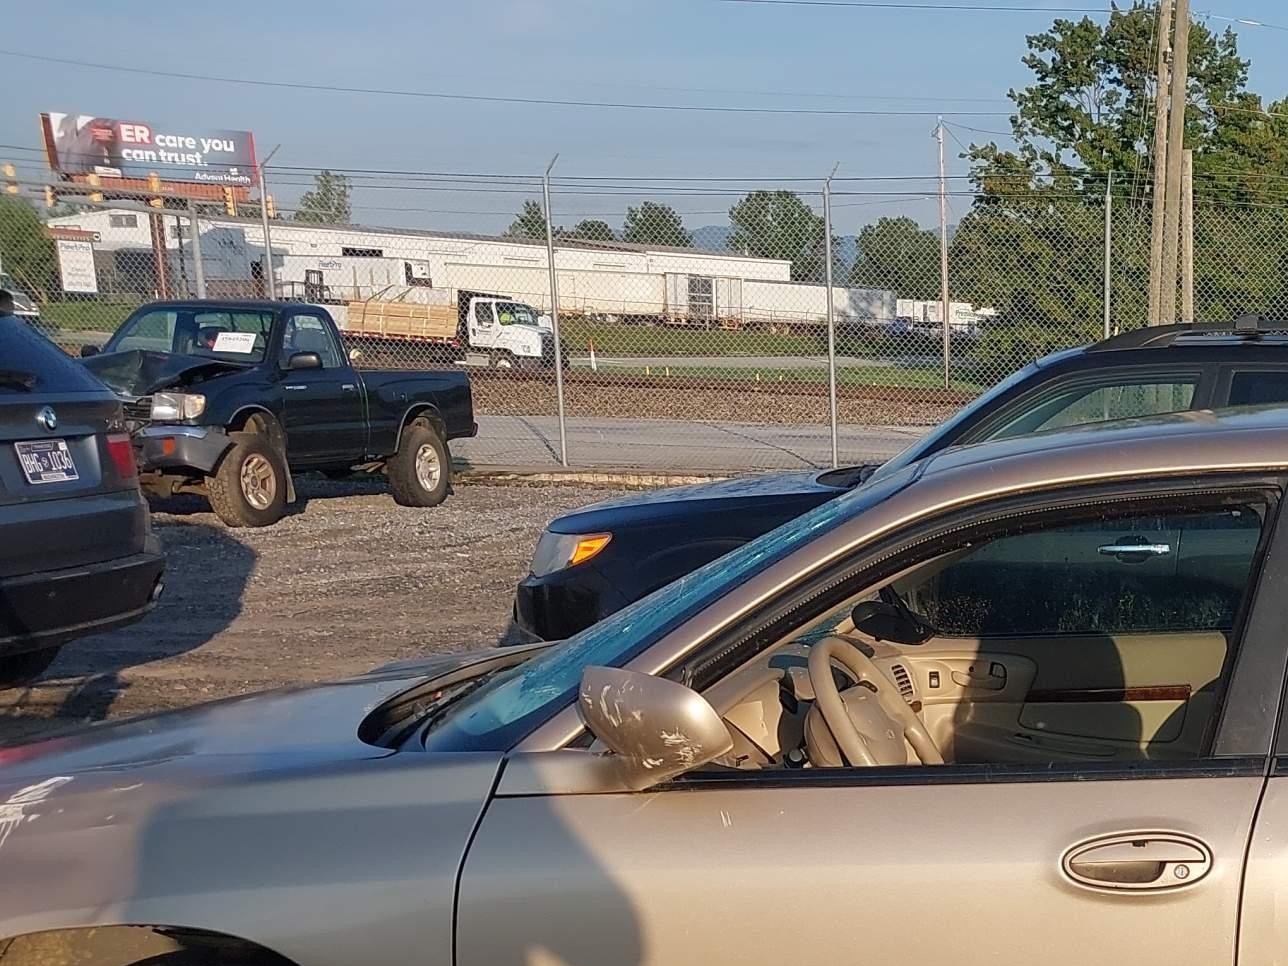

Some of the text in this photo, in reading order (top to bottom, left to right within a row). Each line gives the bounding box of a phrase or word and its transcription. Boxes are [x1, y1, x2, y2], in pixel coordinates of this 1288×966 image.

[120, 124, 235, 154] ER care you
[121, 147, 208, 167] can trust.
